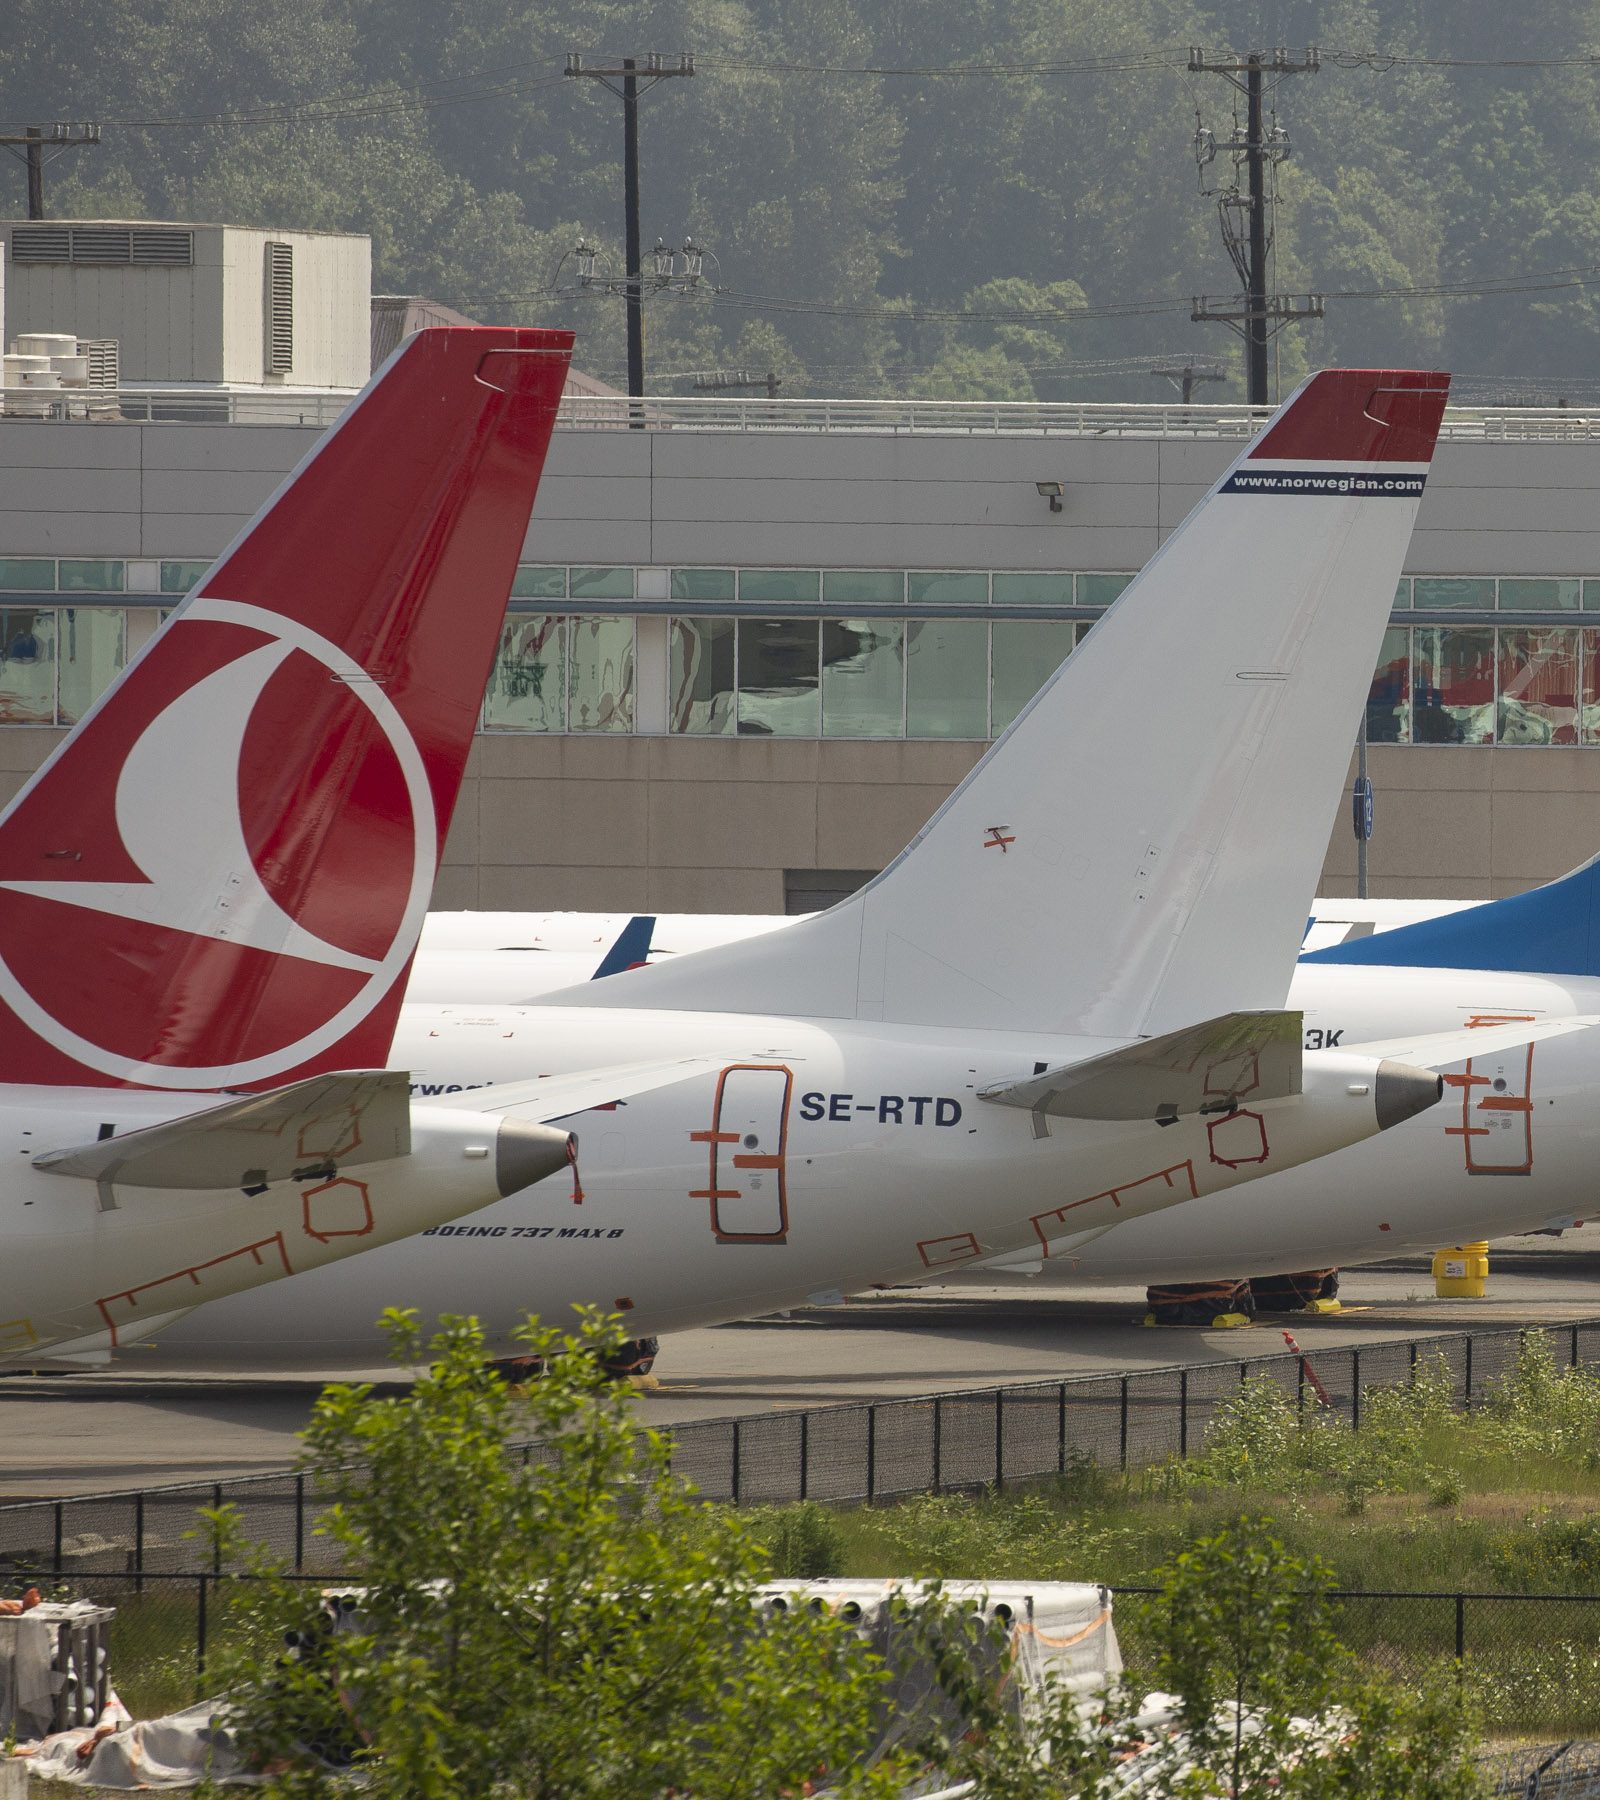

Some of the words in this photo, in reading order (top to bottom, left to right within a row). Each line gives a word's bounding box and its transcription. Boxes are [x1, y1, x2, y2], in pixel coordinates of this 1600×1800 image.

[1234, 477, 1423, 491] www.norwegian.com
[799, 1092, 963, 1128] SE-RTD
[422, 1226, 507, 1237] BOEING
[510, 1227, 555, 1238] 737
[556, 1228, 606, 1239] MAX
[606, 1228, 625, 1239] 8
